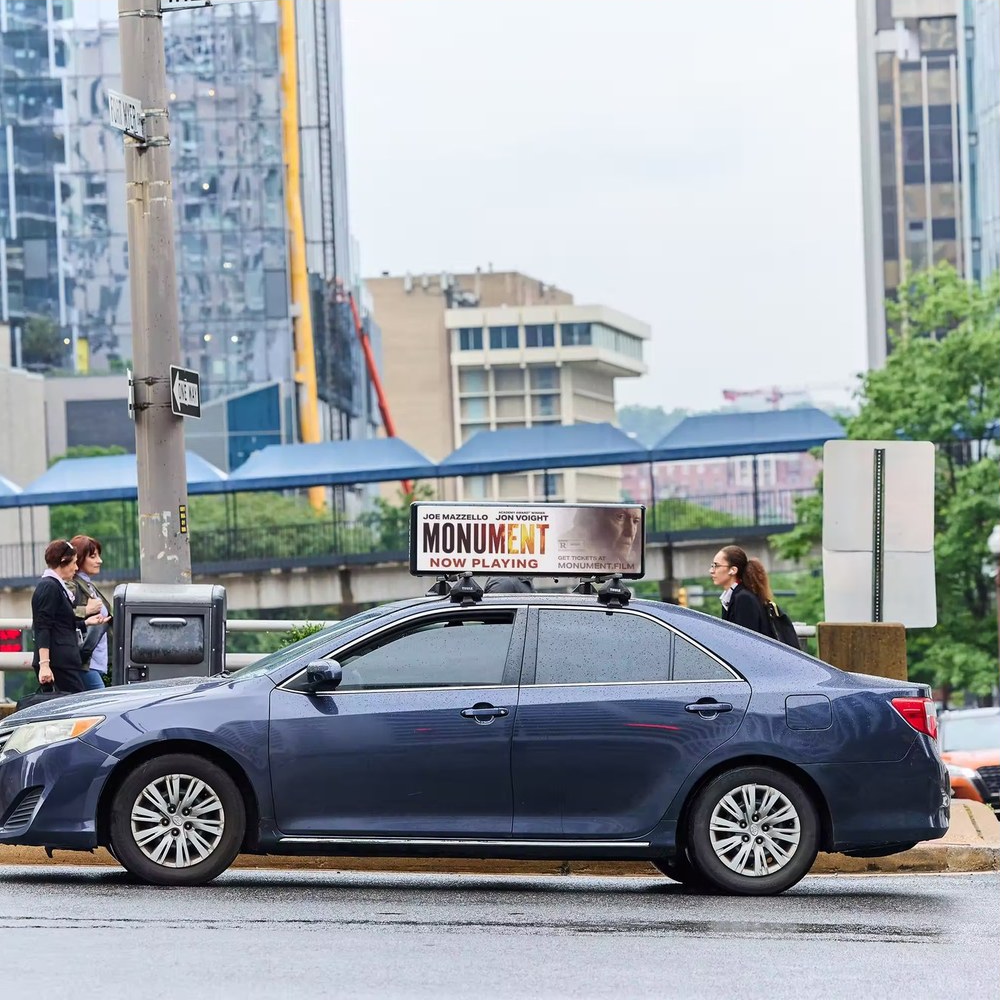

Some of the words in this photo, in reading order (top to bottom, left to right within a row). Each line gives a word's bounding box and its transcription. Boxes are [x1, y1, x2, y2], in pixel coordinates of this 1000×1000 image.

[178, 383, 188, 402] ONE
[188, 385, 197, 404] WAY
[423, 522, 550, 554] MONUMENT
[430, 558, 467, 568] NOW
[472, 558, 538, 569] PLAYING
